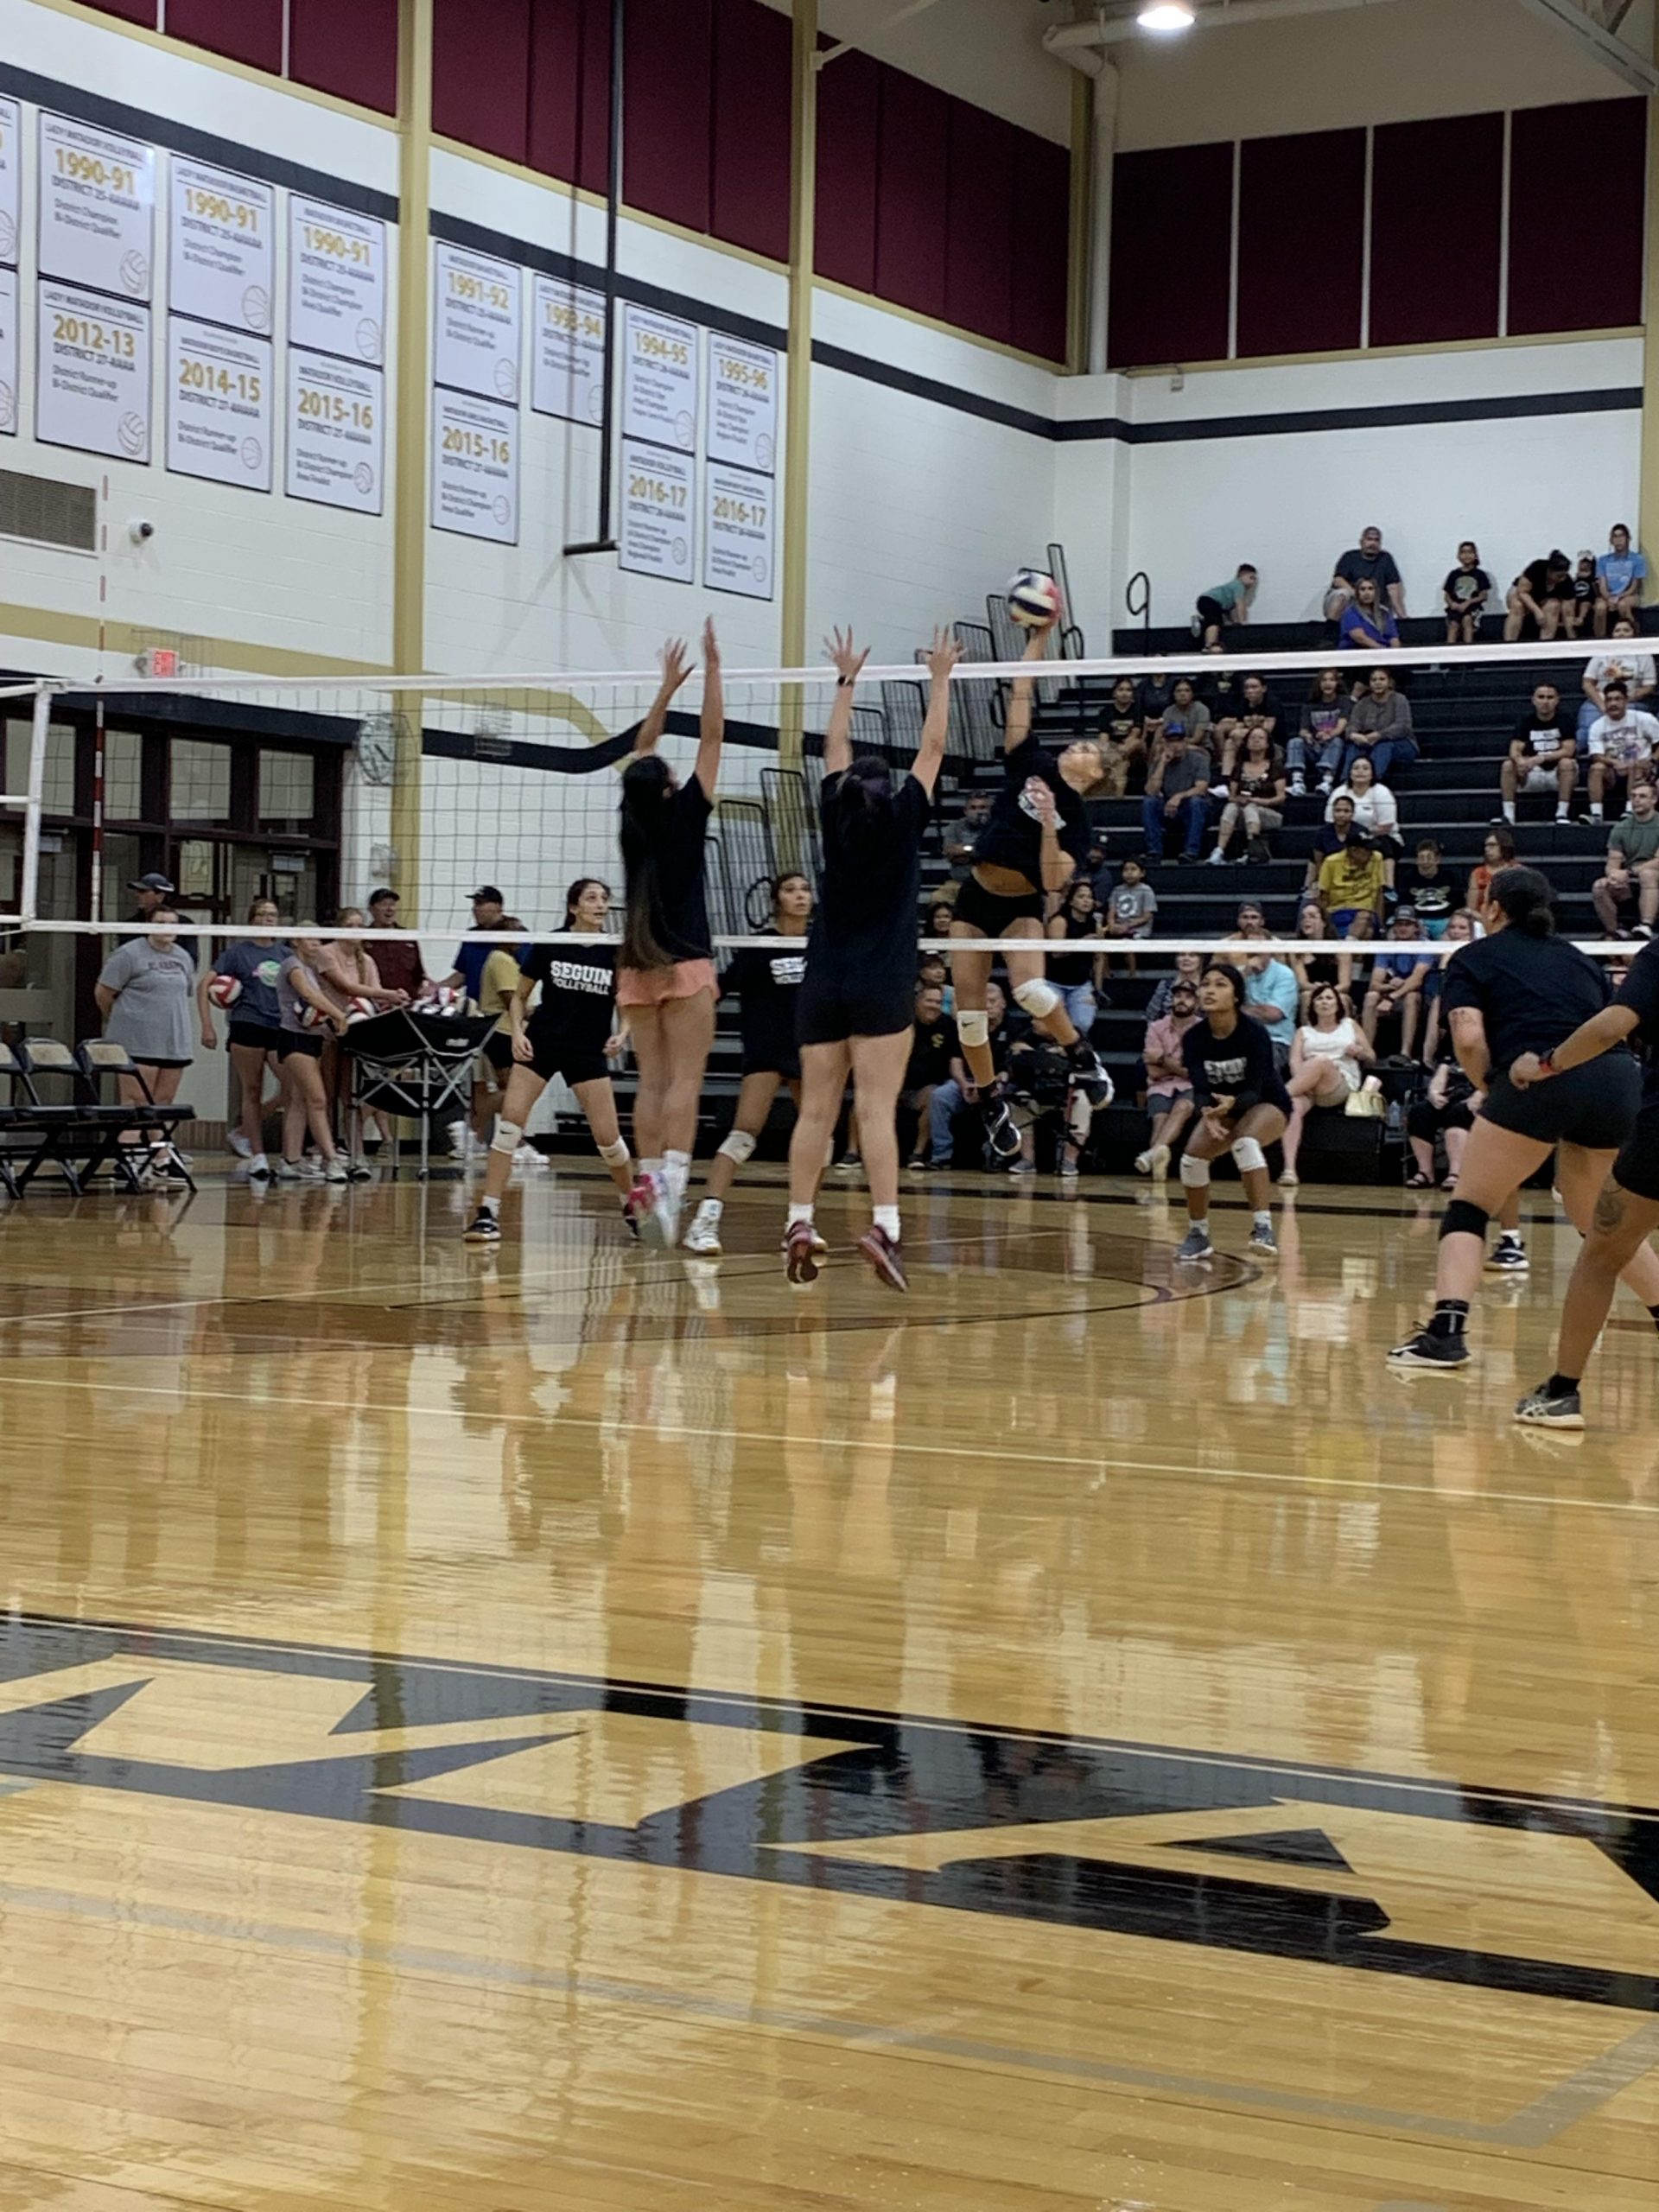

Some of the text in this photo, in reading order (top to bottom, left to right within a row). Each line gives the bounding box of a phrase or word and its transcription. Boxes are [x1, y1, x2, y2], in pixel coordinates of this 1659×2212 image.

[51, 175, 92, 196] DISTRICT
[54, 145, 135, 195] 1990-91
[181, 216, 218, 236] DISTRICT
[184, 187, 257, 232] 1990-91
[302, 225, 369, 266] 1990-91
[447, 270, 508, 309] 1991-92
[53, 312, 133, 357] 2012-13
[634, 331, 687, 365] 1994-95
[53, 343, 94, 361] DISTRICT
[178, 357, 260, 403] 2014-15
[718, 357, 767, 391] 1995-96
[179, 390, 216, 407] DISTRICT
[297, 387, 372, 430] 2015-16
[297, 418, 331, 435] DISTRICT
[442, 425, 509, 464] 2015-16
[628, 473, 686, 509] 2016-17
[712, 494, 766, 528] 2016-17
[550, 959, 613, 987] SEGUIN
[551, 977, 609, 995] VOLLEYBALL
